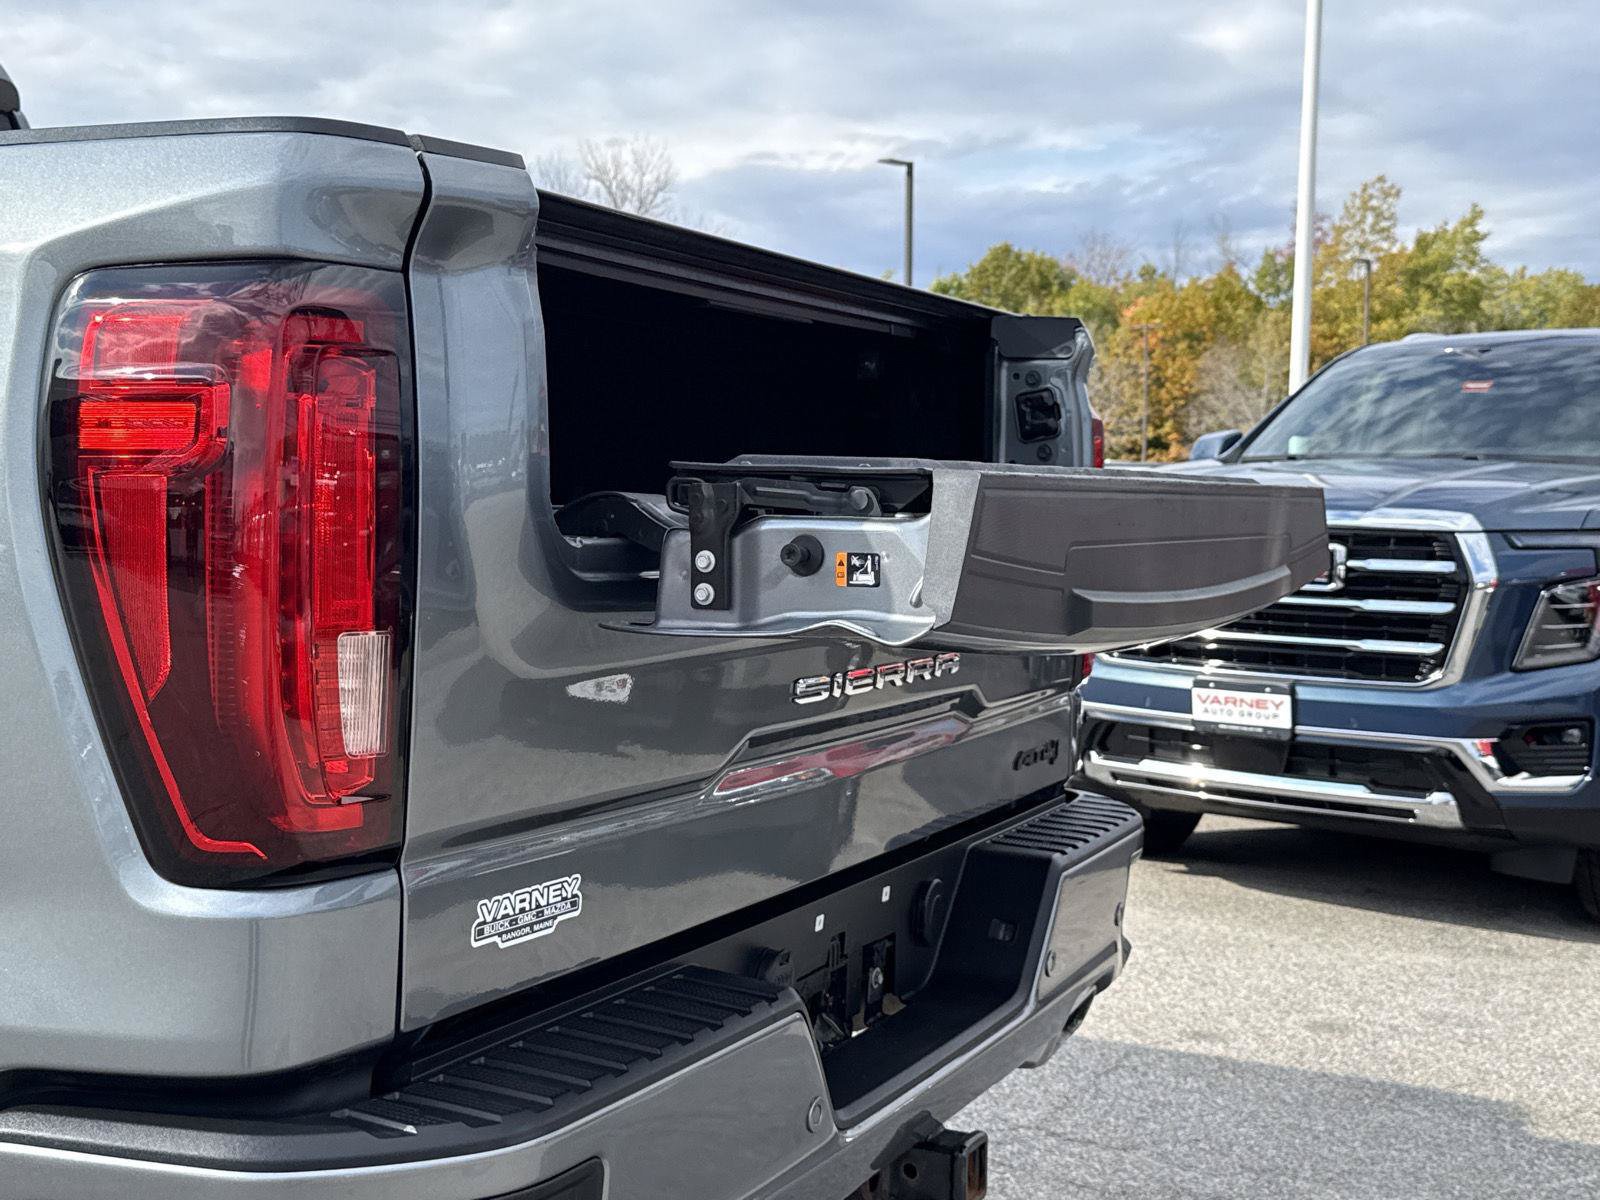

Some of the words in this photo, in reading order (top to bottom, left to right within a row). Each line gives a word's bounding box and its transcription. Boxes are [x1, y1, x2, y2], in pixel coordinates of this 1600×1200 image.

[792, 652, 961, 705] SIERRA
[1196, 692, 1285, 711] VARNEY
[1202, 706, 1234, 717] AUTO
[1238, 709, 1280, 720] GROUP
[480, 878, 578, 923] VARNEY
[483, 919, 510, 935] BUICK
[517, 911, 538, 926] GMC
[543, 901, 572, 917] MAZDA
[501, 926, 532, 941] BANGOR,
[532, 918, 554, 932] MAINE
